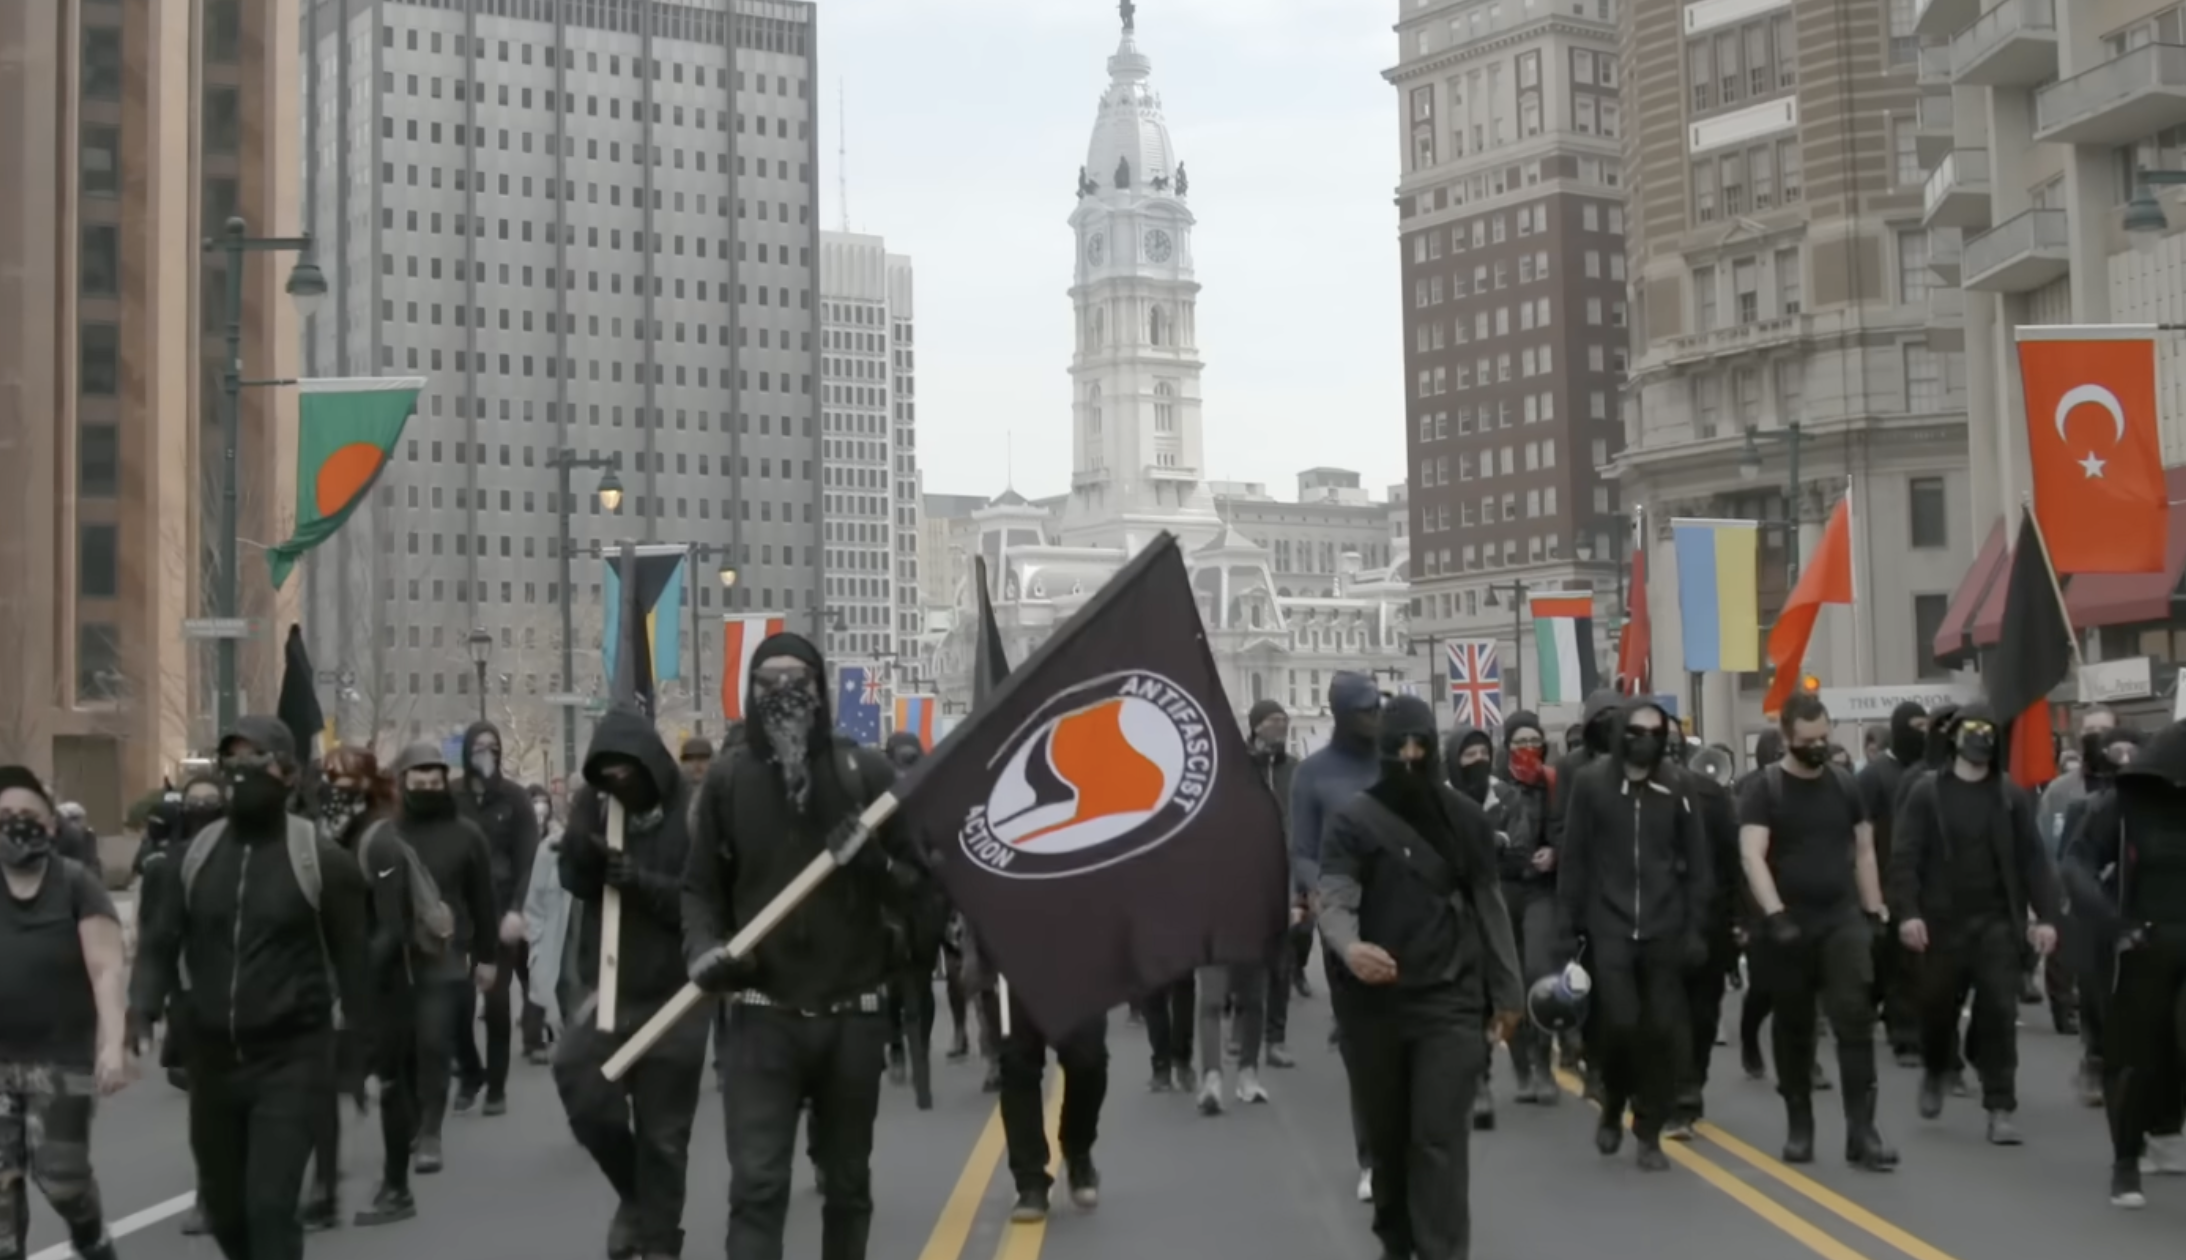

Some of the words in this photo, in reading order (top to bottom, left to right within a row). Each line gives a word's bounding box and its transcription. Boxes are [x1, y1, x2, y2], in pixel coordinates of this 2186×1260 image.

[1849, 697, 1877, 710] THE
[1118, 676, 1209, 813] ANTIFASCIST
[964, 804, 1016, 868] ACTION
